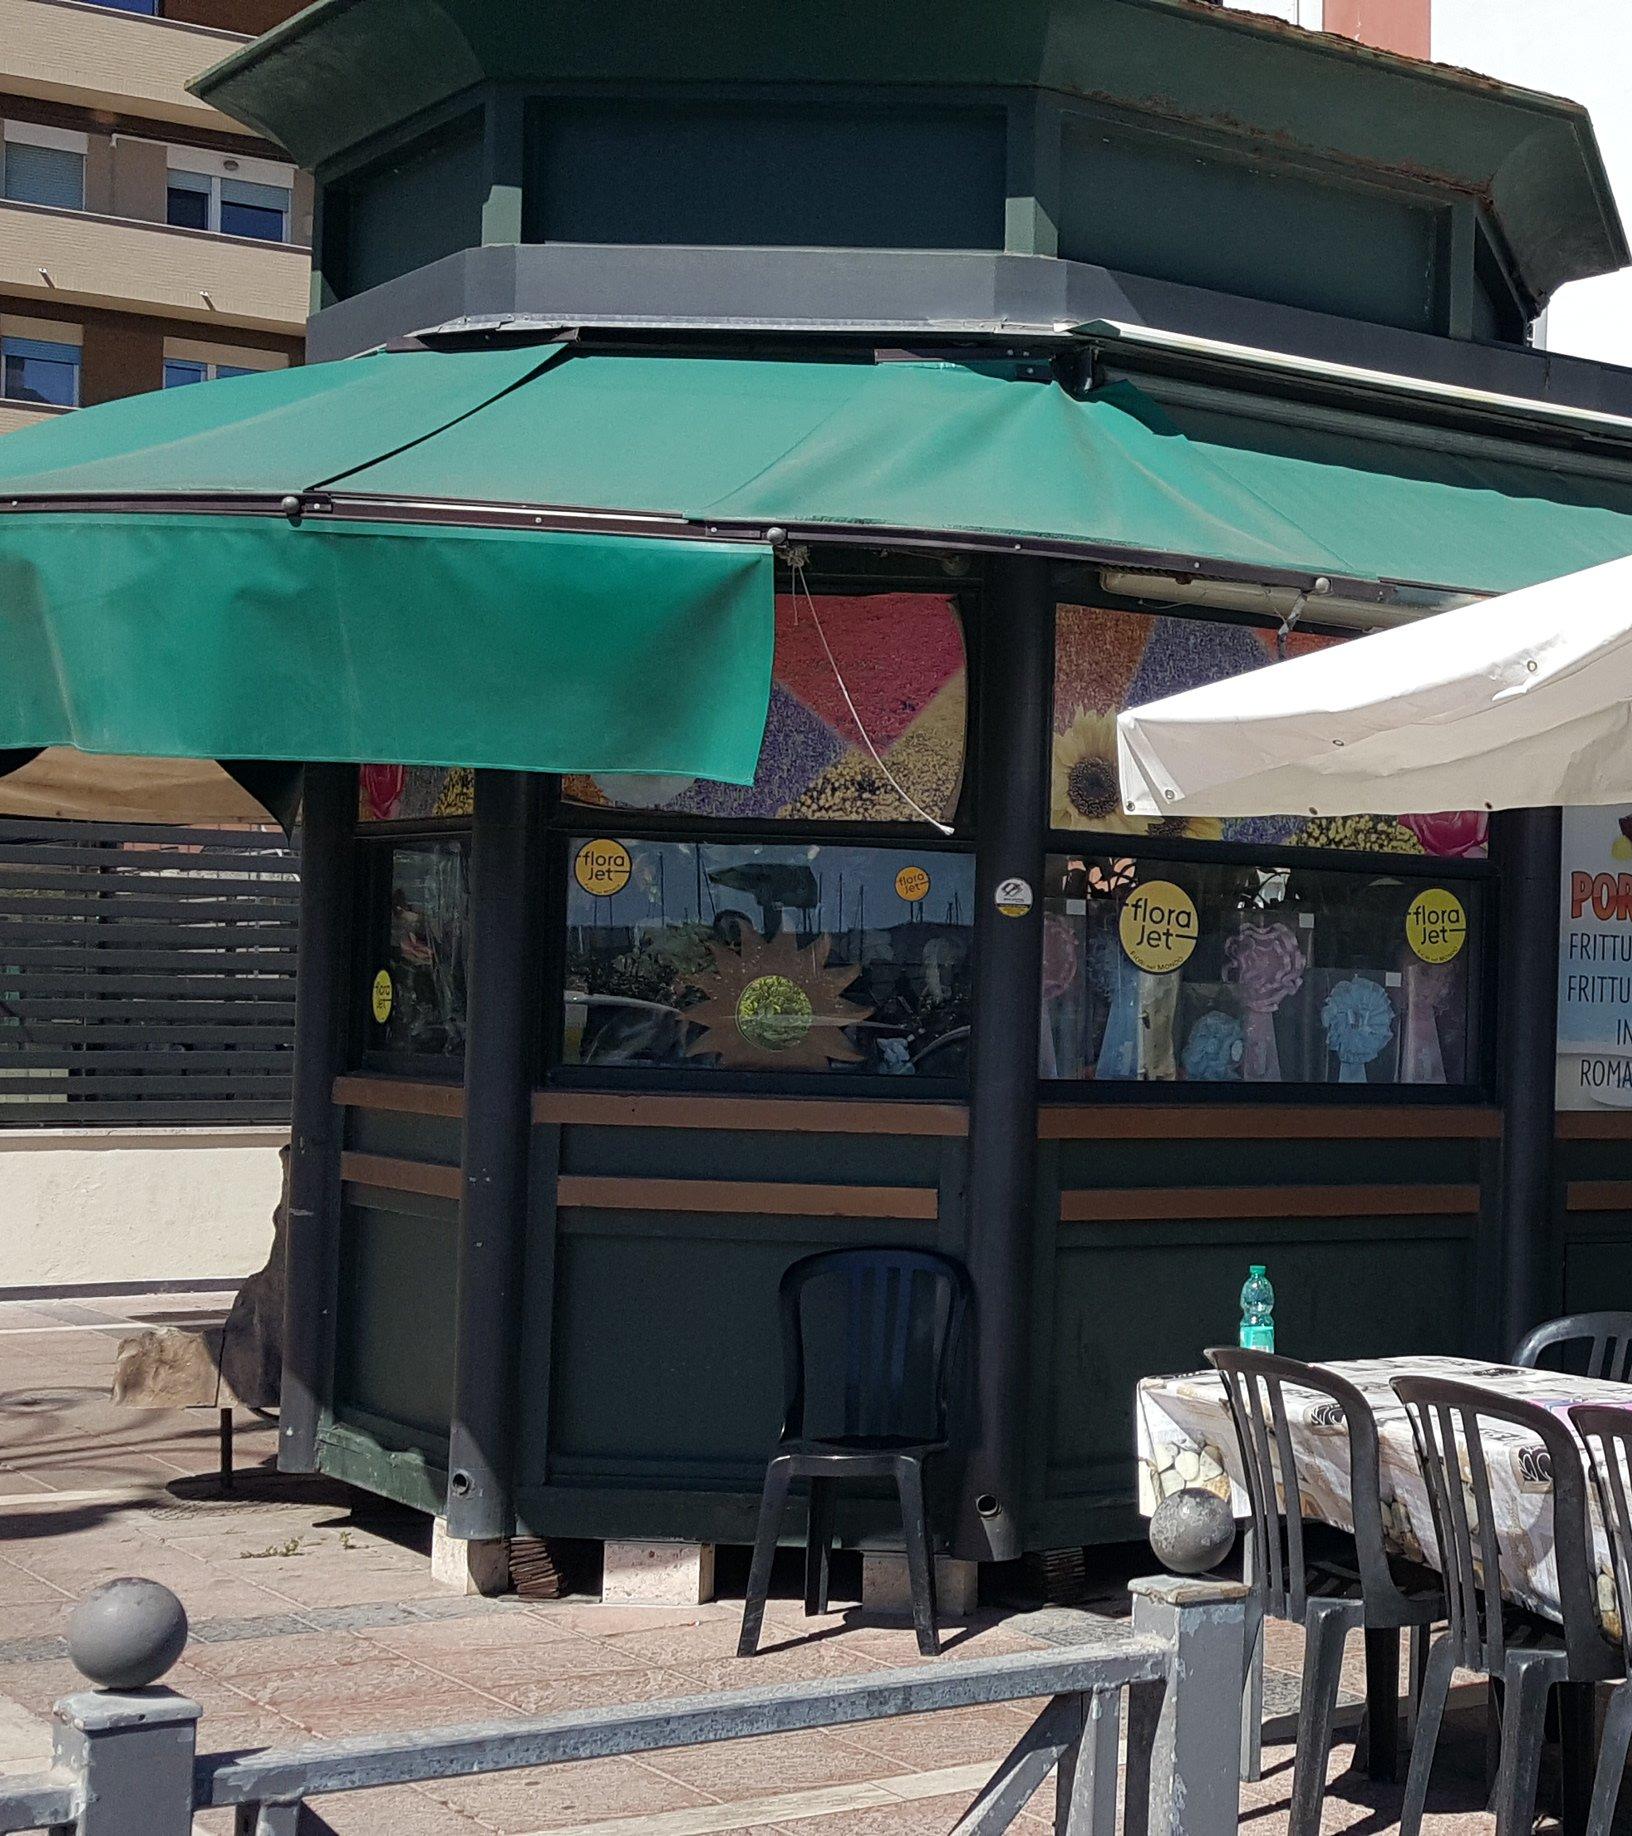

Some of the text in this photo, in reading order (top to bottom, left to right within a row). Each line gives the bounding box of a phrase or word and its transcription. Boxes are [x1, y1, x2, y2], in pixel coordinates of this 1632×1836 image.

[582, 851, 625, 867] flora
[899, 872, 925, 887] flora
[1131, 898, 1191, 928] flora
[1413, 905, 1460, 926] flora
